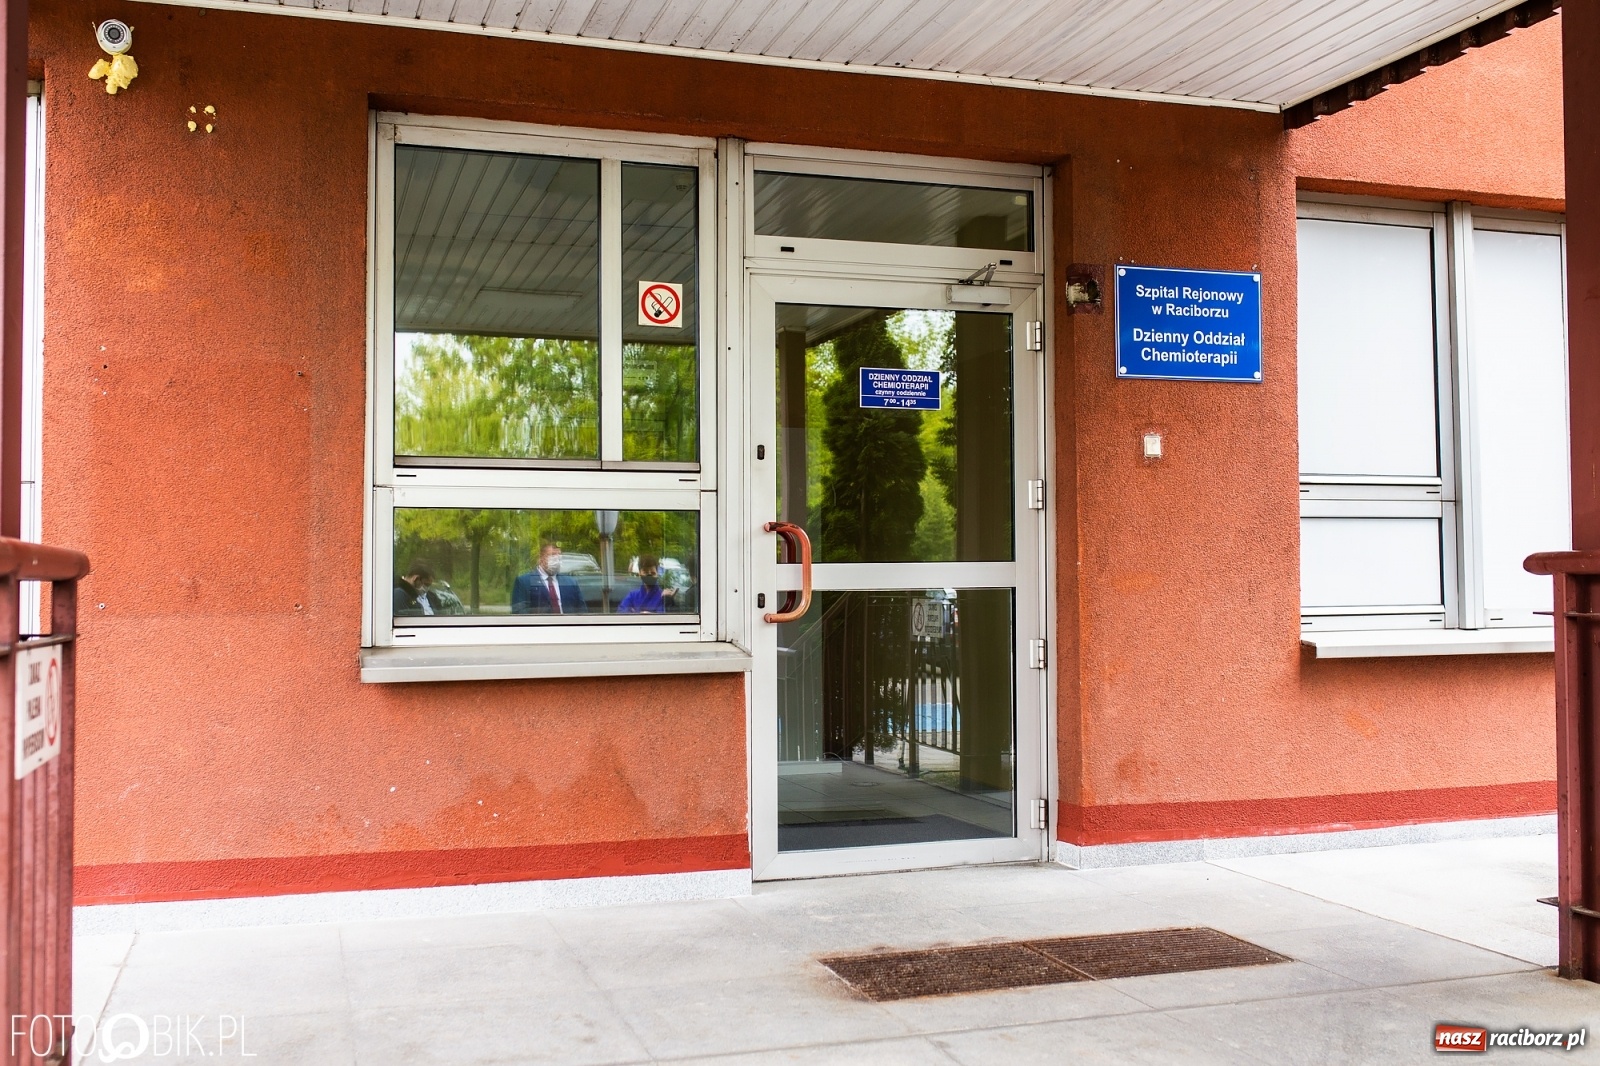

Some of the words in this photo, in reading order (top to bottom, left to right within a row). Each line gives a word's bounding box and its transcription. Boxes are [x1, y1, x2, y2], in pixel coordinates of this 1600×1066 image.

[1136, 285, 1179, 300] Szpital
[1182, 287, 1244, 304] Rejonowy
[1152, 305, 1162, 315] w
[1166, 303, 1229, 318] Raciborzu
[1133, 328, 1189, 347] Dzienny
[1193, 331, 1245, 346] Oddział
[1141, 347, 1238, 367] Chemioterapii
[868, 373, 900, 381] DZIENNY
[901, 374, 933, 383] ODDZIAŁ
[872, 381, 929, 390] CHEMIOTERAPII
